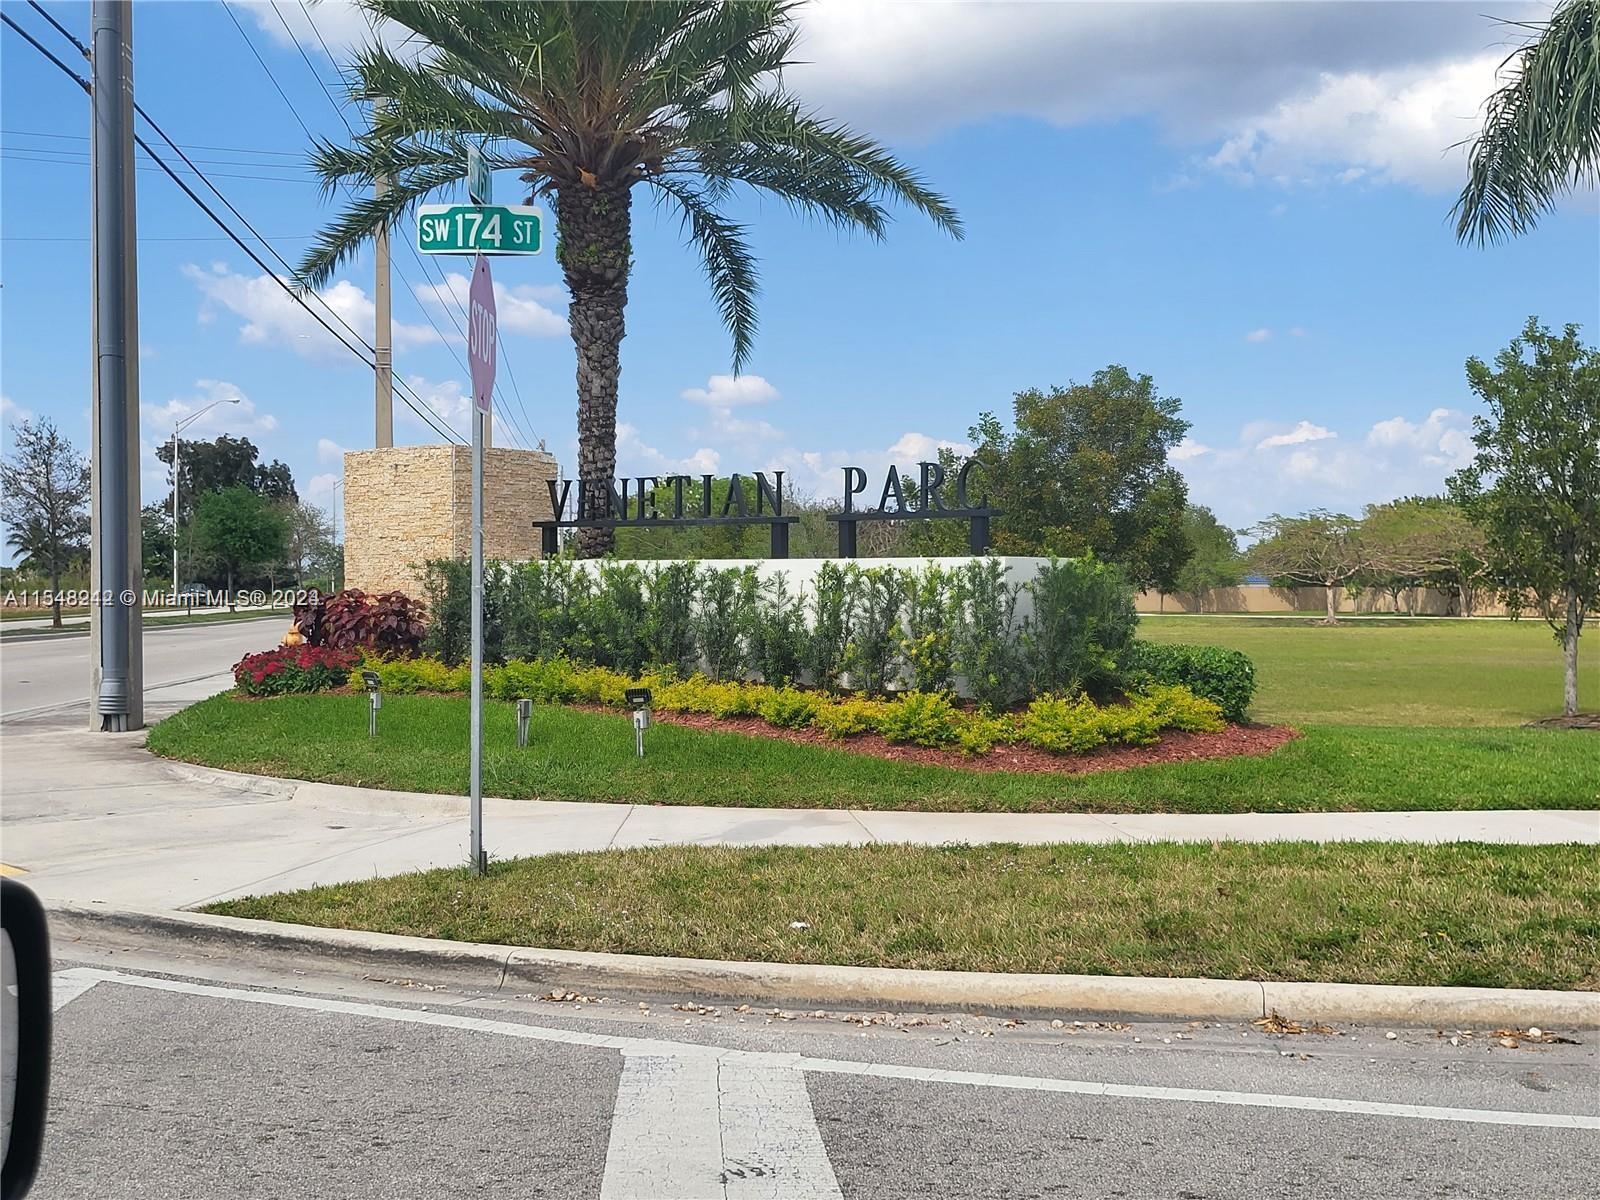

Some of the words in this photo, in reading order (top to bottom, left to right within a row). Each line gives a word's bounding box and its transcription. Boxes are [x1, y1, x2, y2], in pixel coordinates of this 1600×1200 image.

[421, 218, 450, 242] SW
[455, 213, 503, 247] 174
[512, 220, 533, 244] ST
[471, 299, 495, 366] STOP
[545, 471, 786, 523] VENETIAN
[841, 459, 990, 515] PARC
